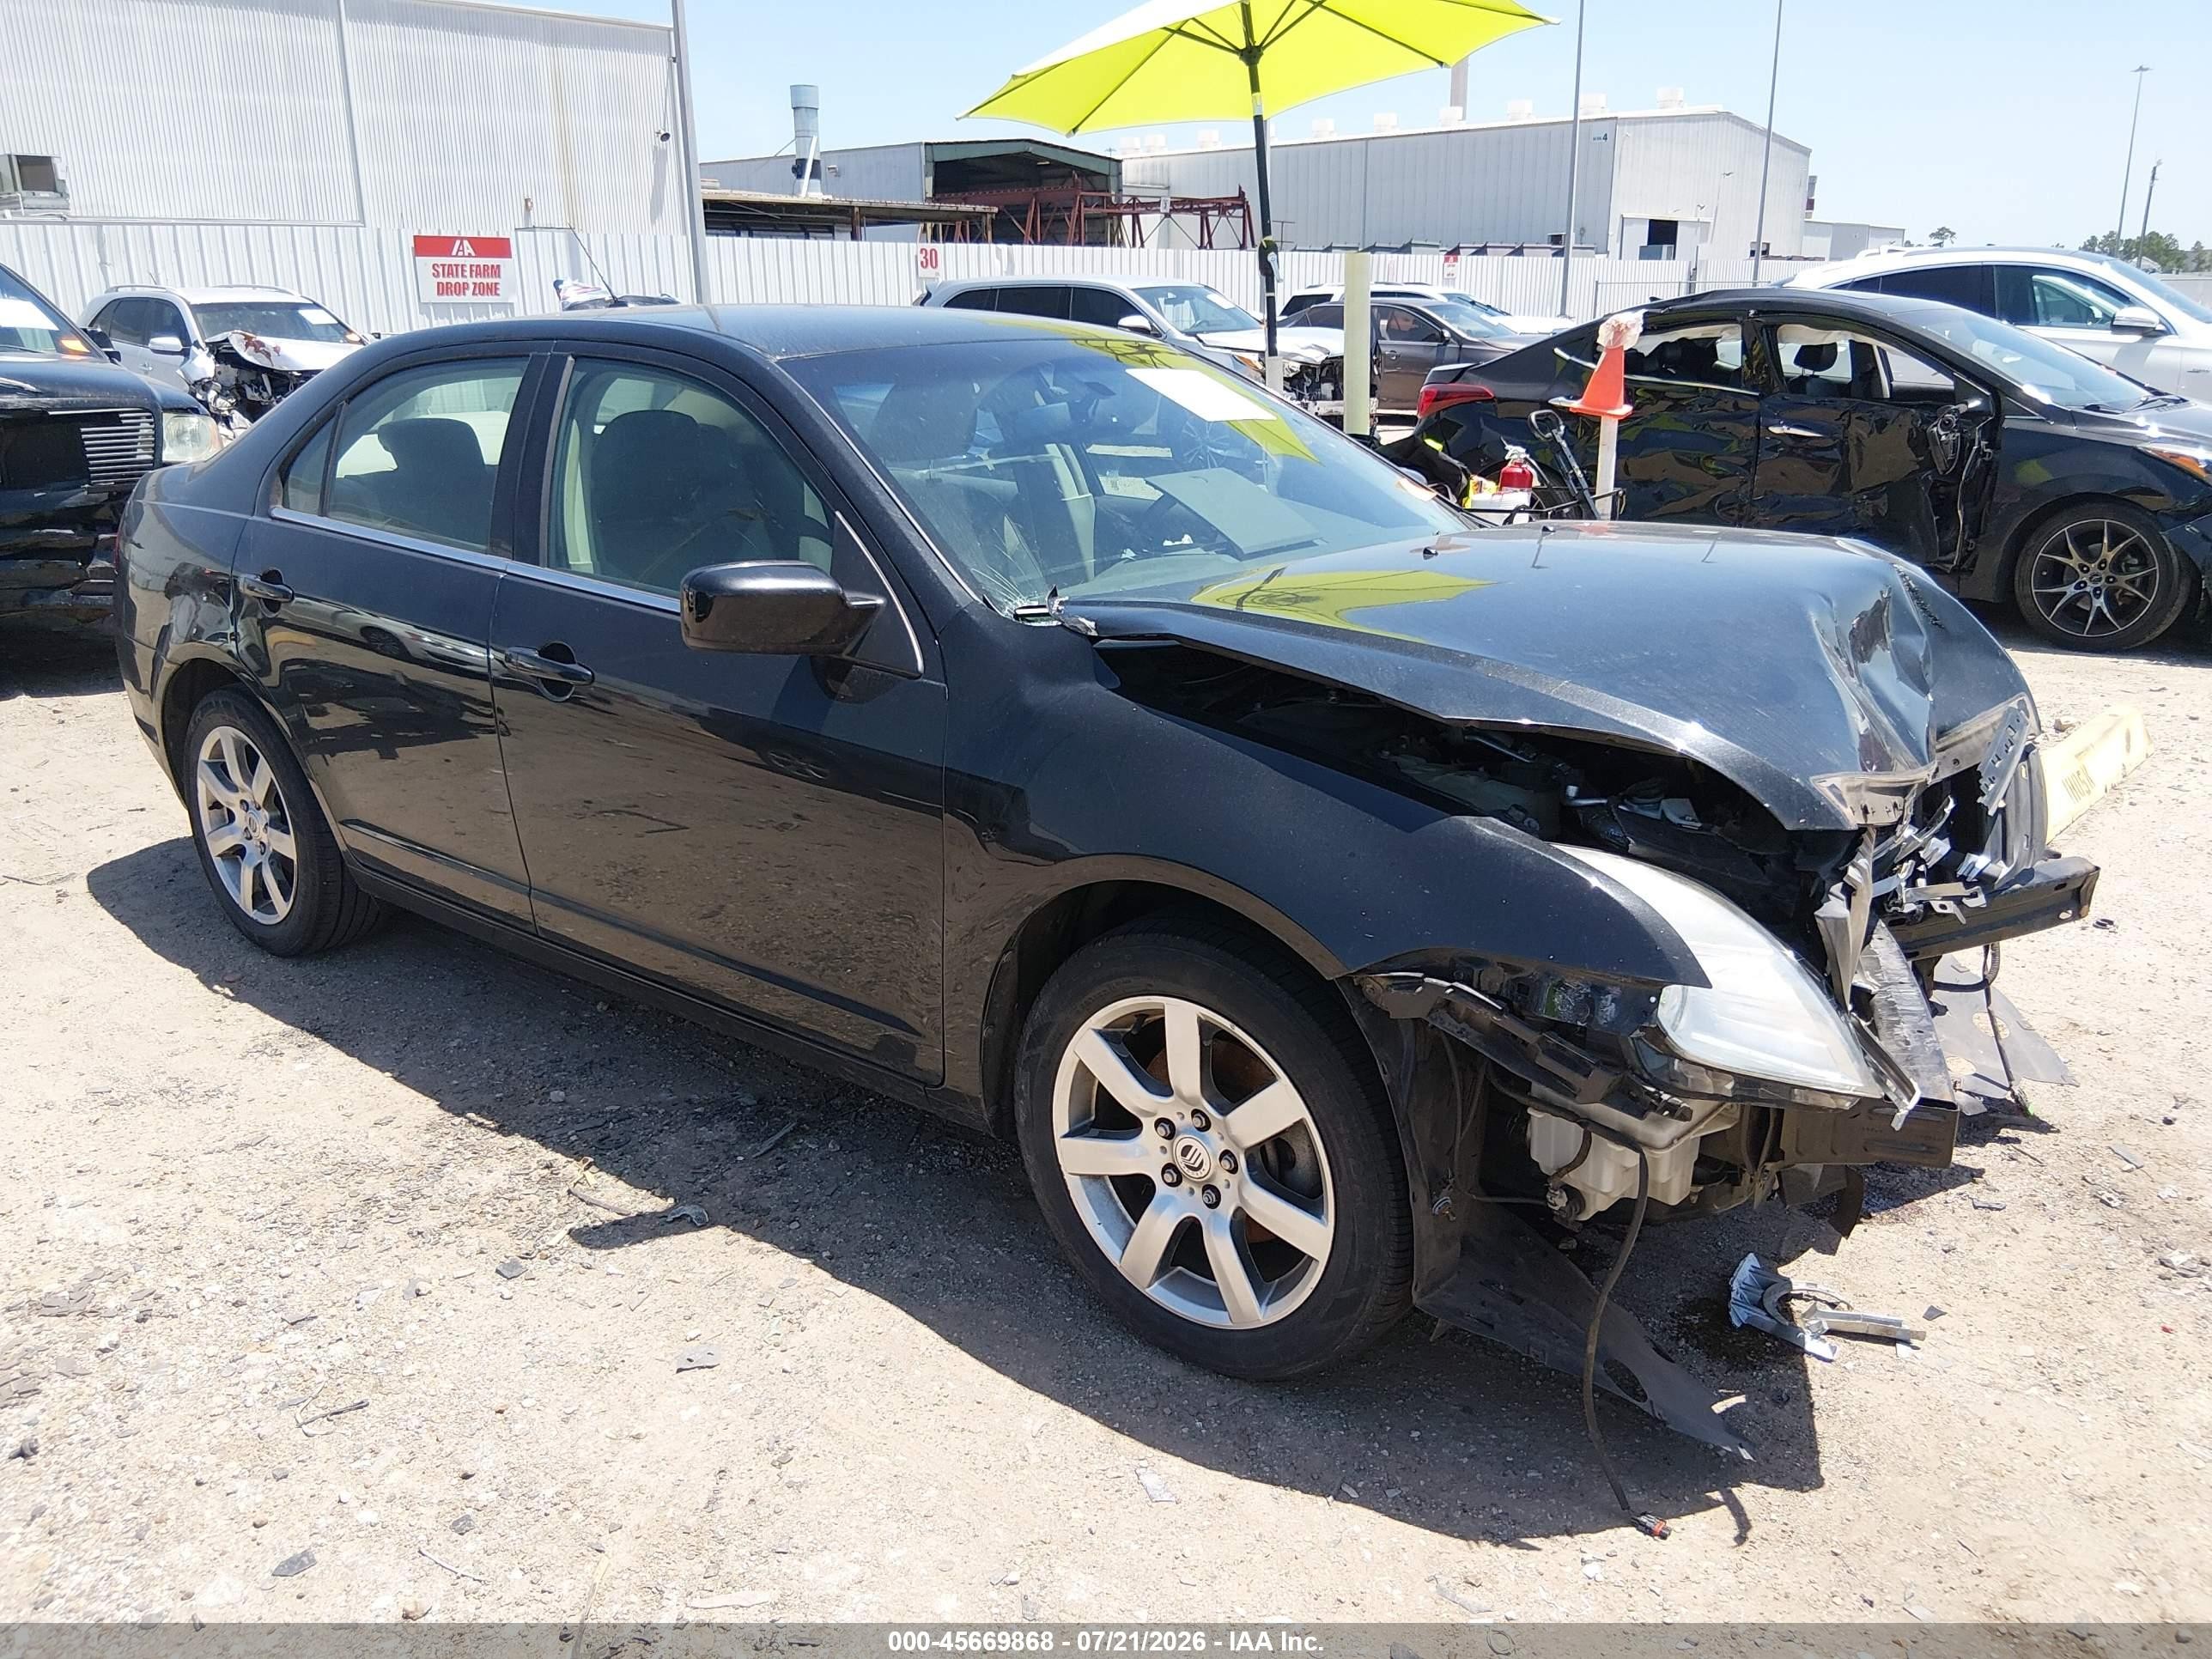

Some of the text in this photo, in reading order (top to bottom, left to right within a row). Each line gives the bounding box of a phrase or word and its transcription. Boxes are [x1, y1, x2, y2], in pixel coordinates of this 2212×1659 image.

[920, 248, 938, 269] 30
[432, 264, 501, 278] STATE FARM
[437, 282, 500, 296] DROP ZONE
